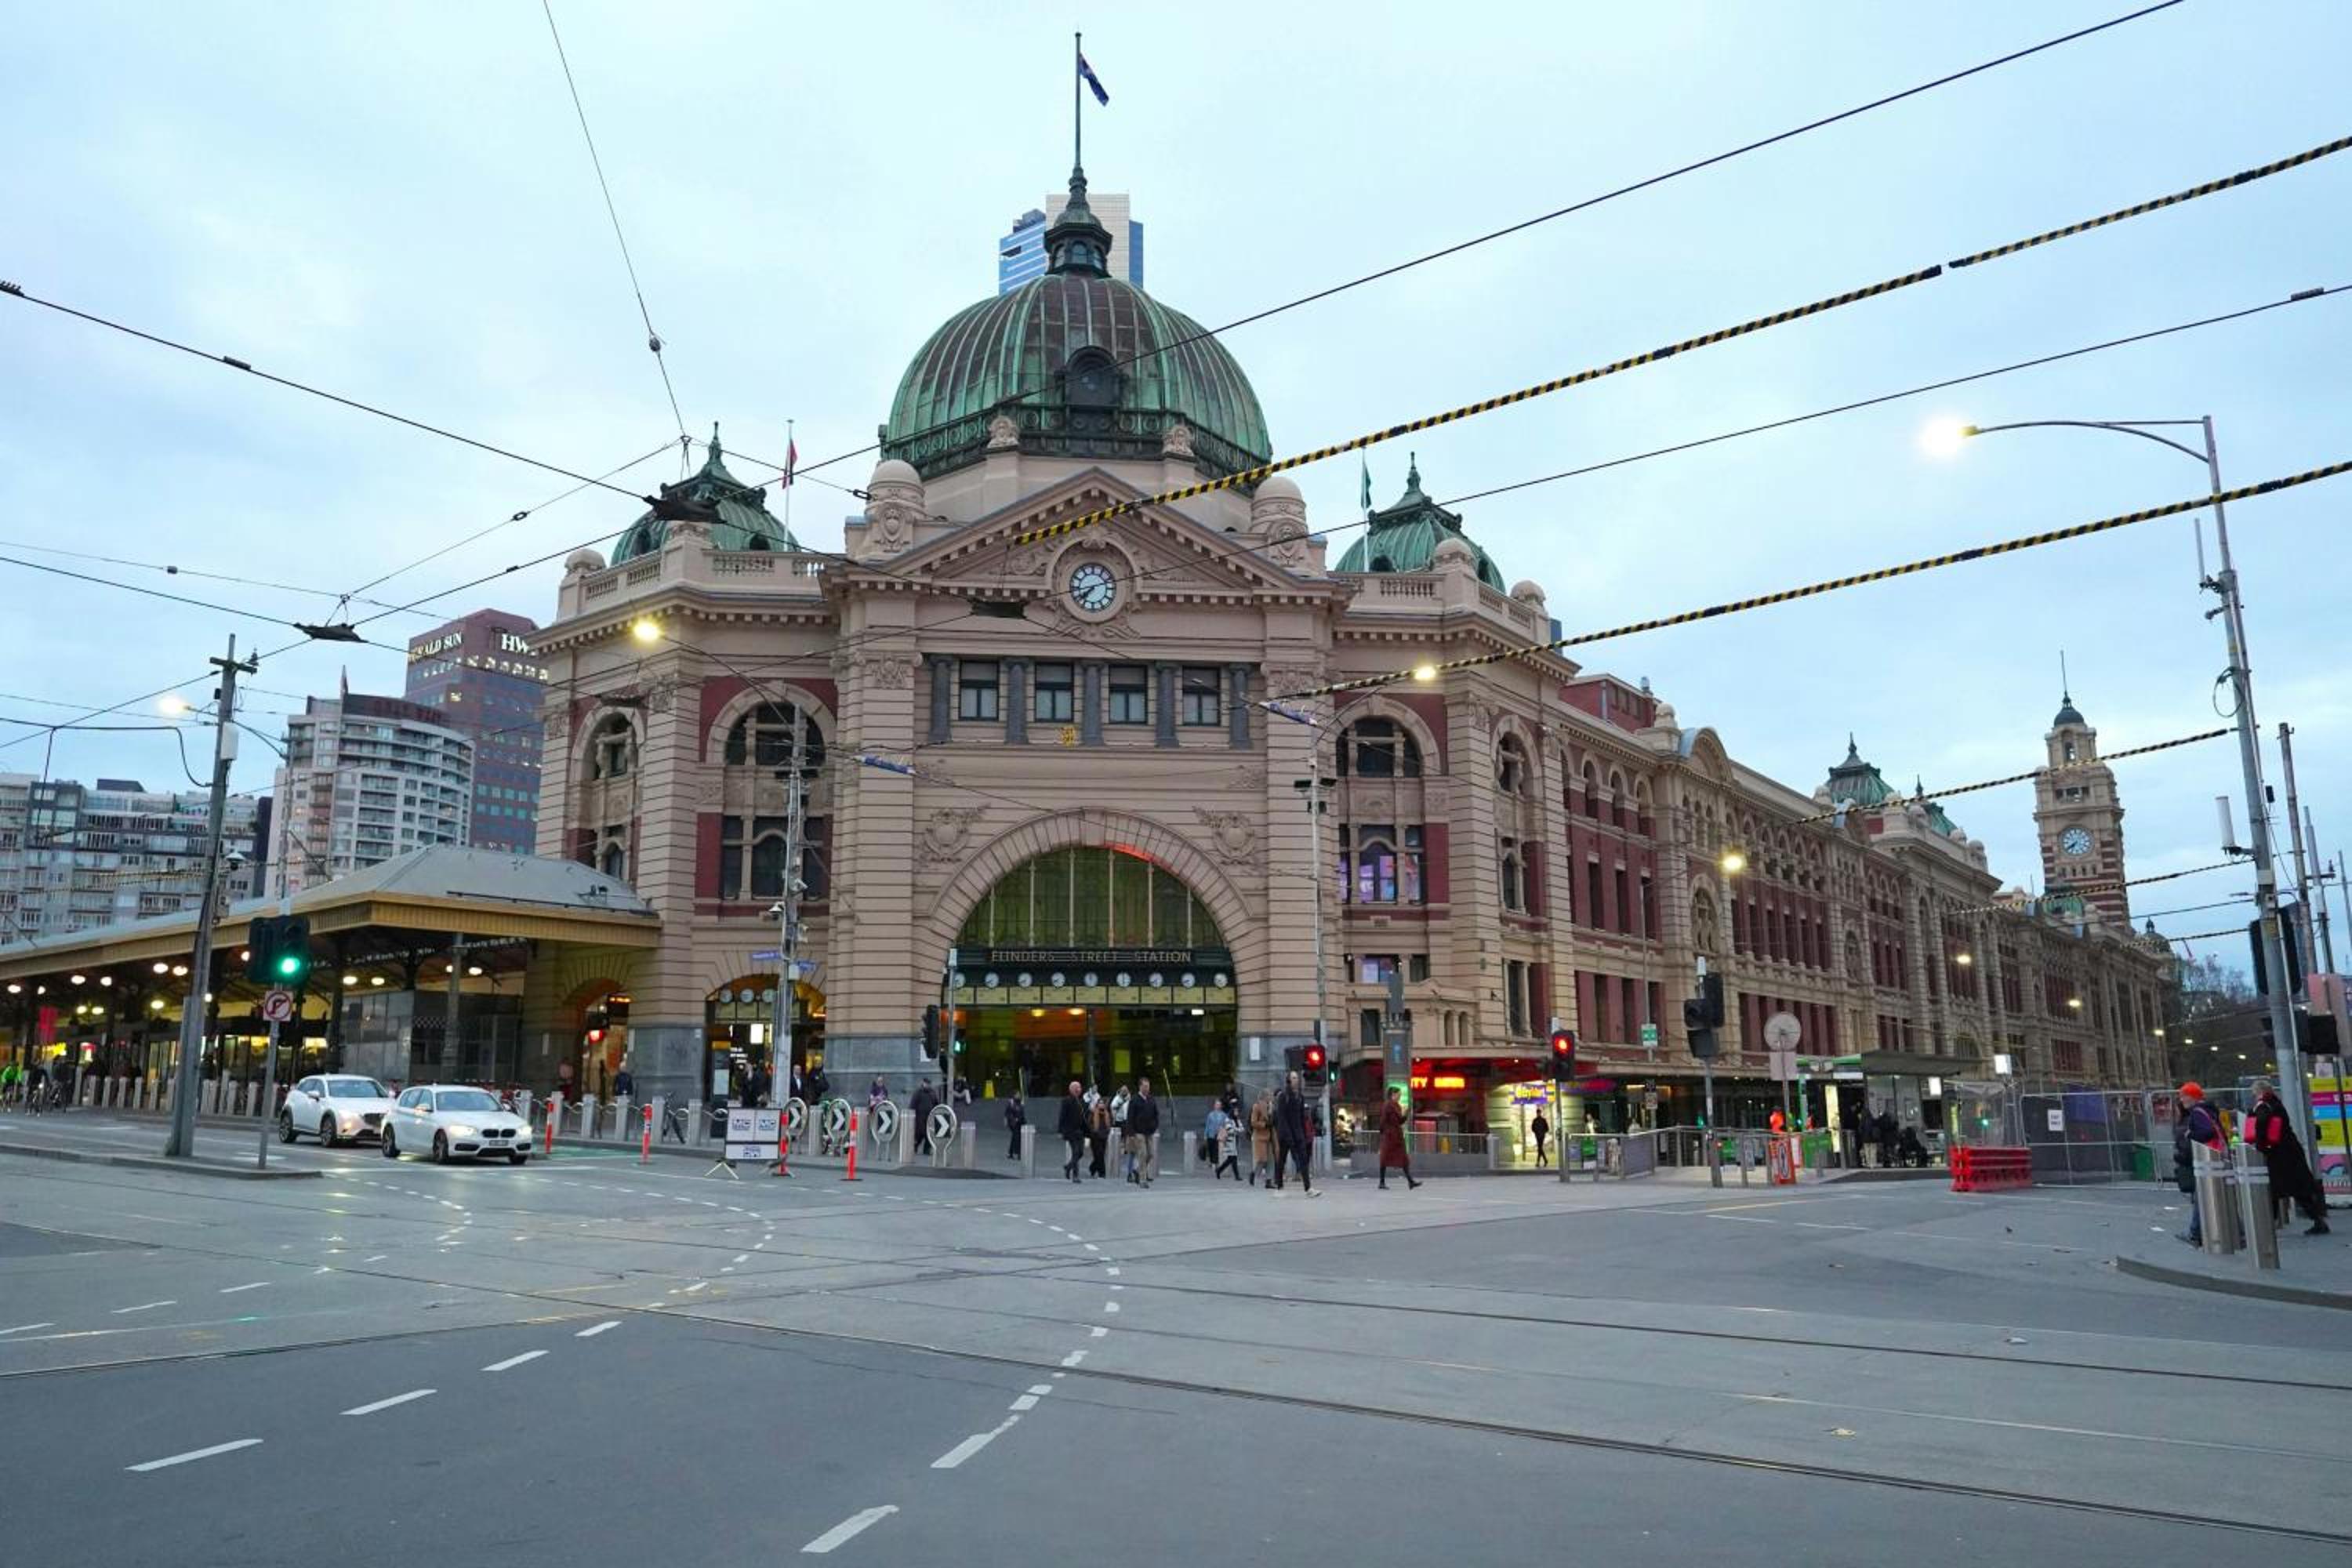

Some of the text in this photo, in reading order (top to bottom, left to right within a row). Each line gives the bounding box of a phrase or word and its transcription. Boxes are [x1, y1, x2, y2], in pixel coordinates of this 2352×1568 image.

[444, 631, 463, 650] SUN
[502, 633, 536, 656] HW
[991, 950, 1192, 963] FLINDERS STREET STATION
